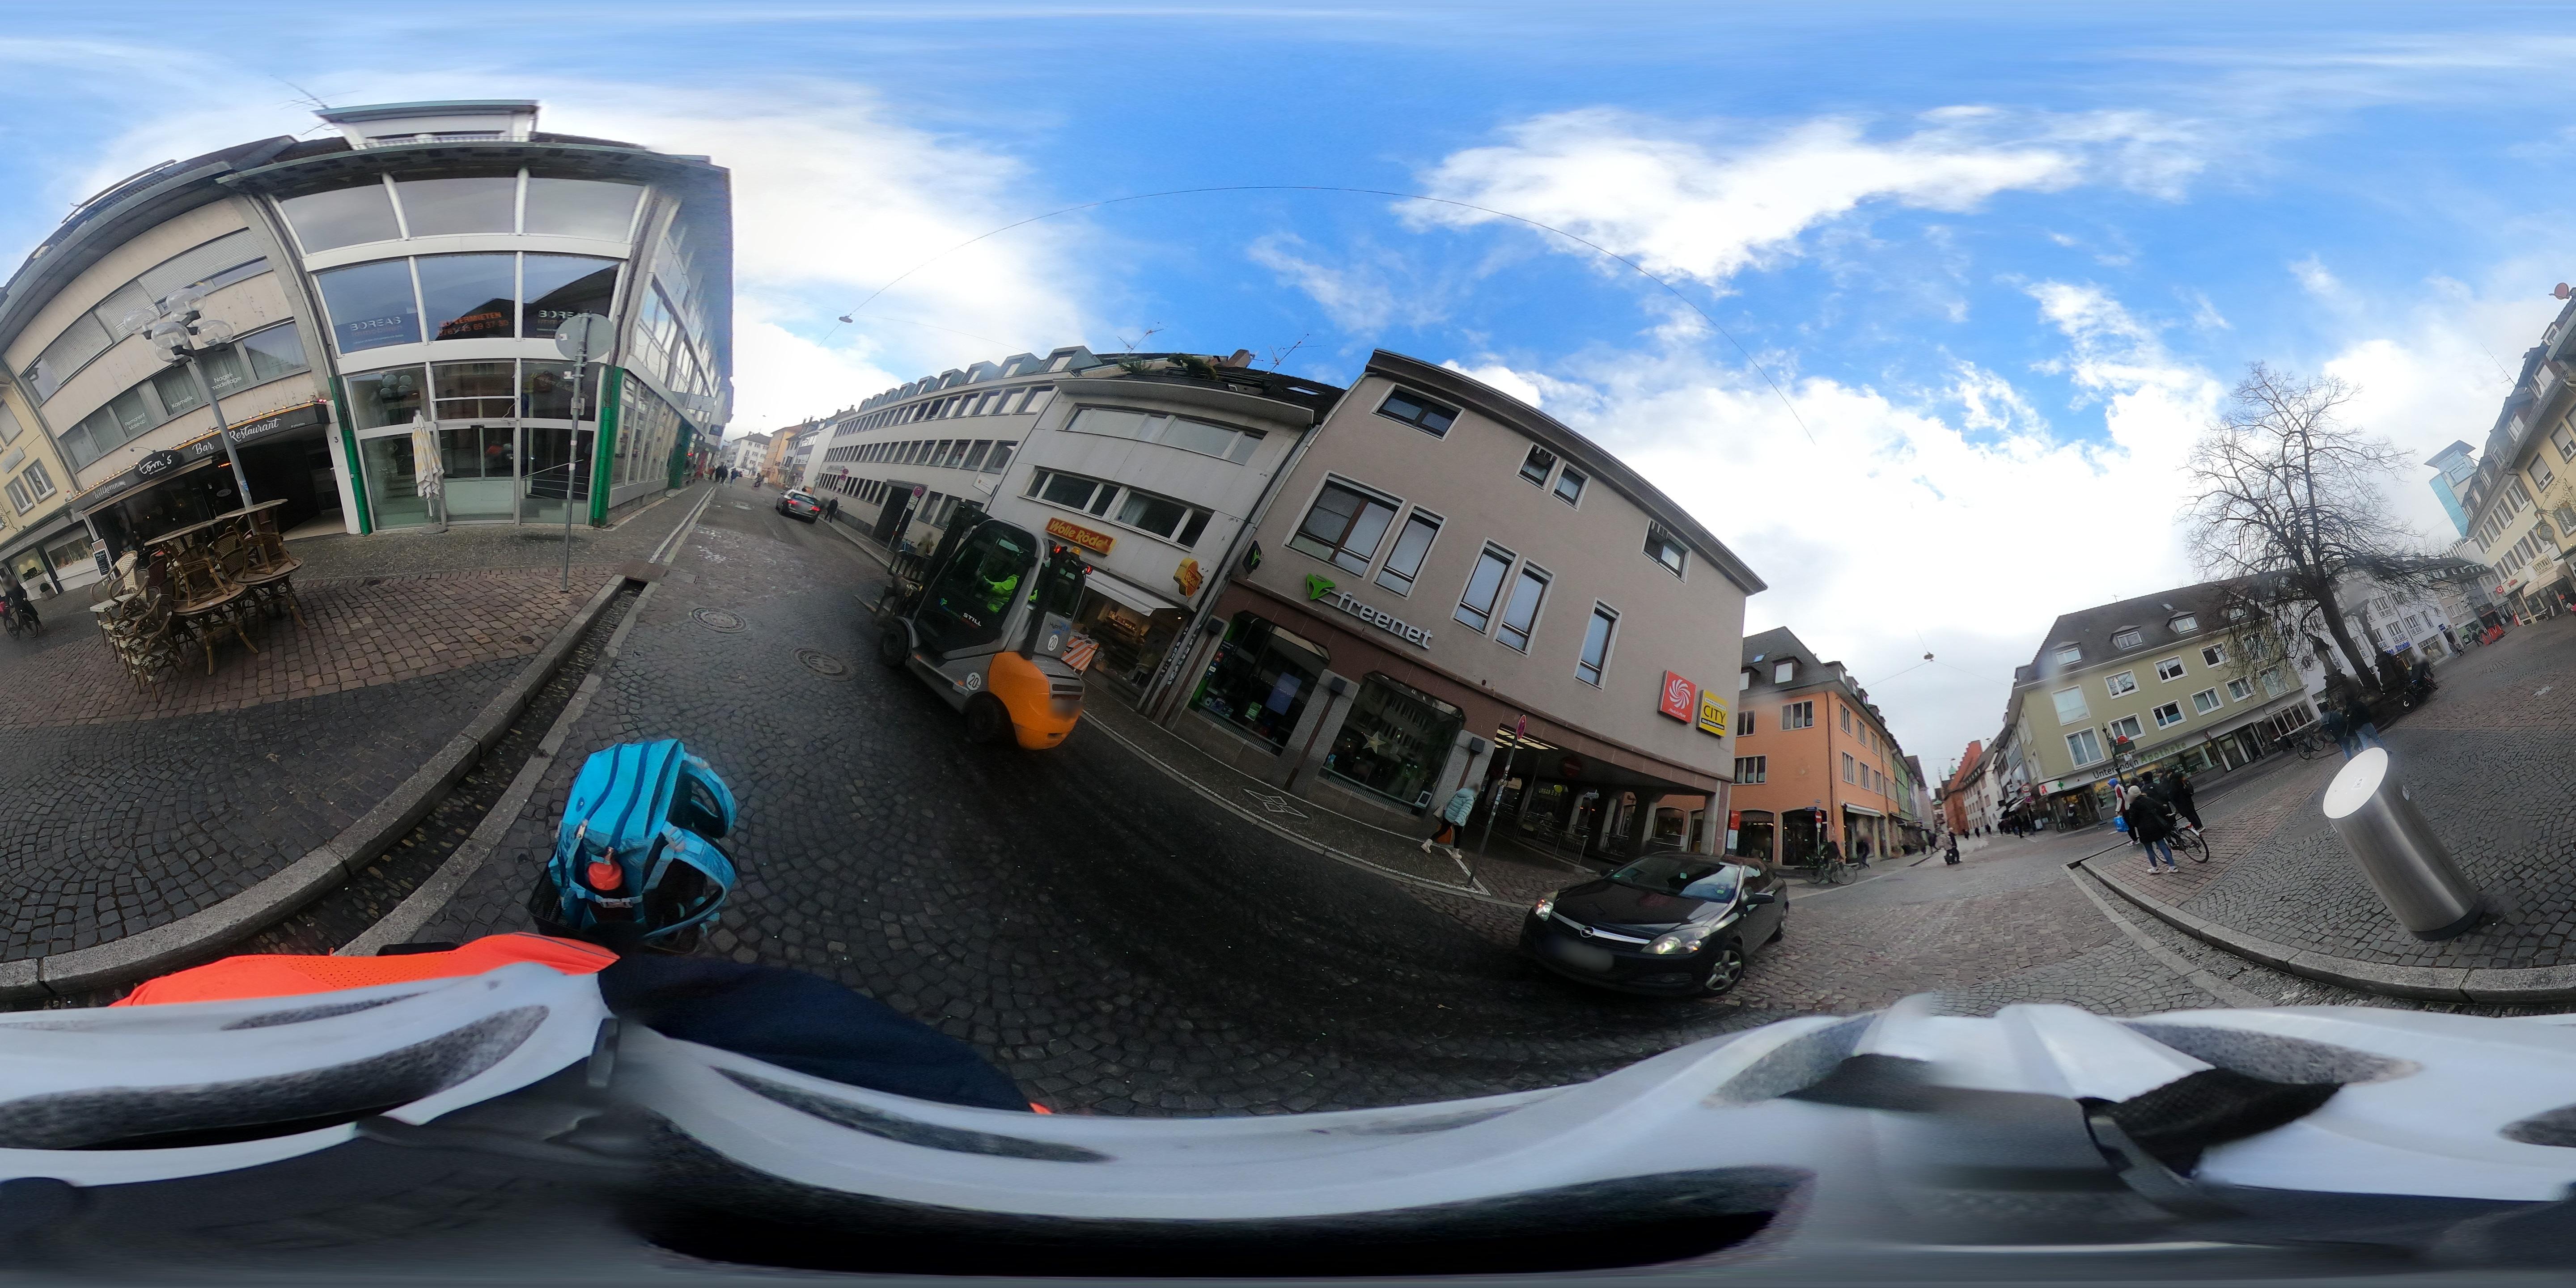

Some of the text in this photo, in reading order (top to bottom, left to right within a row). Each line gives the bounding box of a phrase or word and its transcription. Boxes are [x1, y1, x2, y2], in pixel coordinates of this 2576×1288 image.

[538, 310, 575, 319] BORE
[350, 317, 402, 331] BOREAS
[171, 395, 194, 408] Kosmetik
[125, 412, 145, 426] Permanent
[129, 419, 146, 431] Make-up
[139, 453, 173, 474] tom's
[192, 441, 214, 455] Bar
[229, 418, 281, 442] Restaurant
[1050, 521, 1076, 538] Wolle
[963, 612, 982, 627] STILL
[1337, 591, 1433, 649] freenet
[1049, 637, 1057, 648] 20
[2395, 640, 2411, 652] Striebel
[968, 674, 979, 688] 20
[1703, 705, 1726, 724] CITY
[2140, 741, 2186, 764] Apotheke
